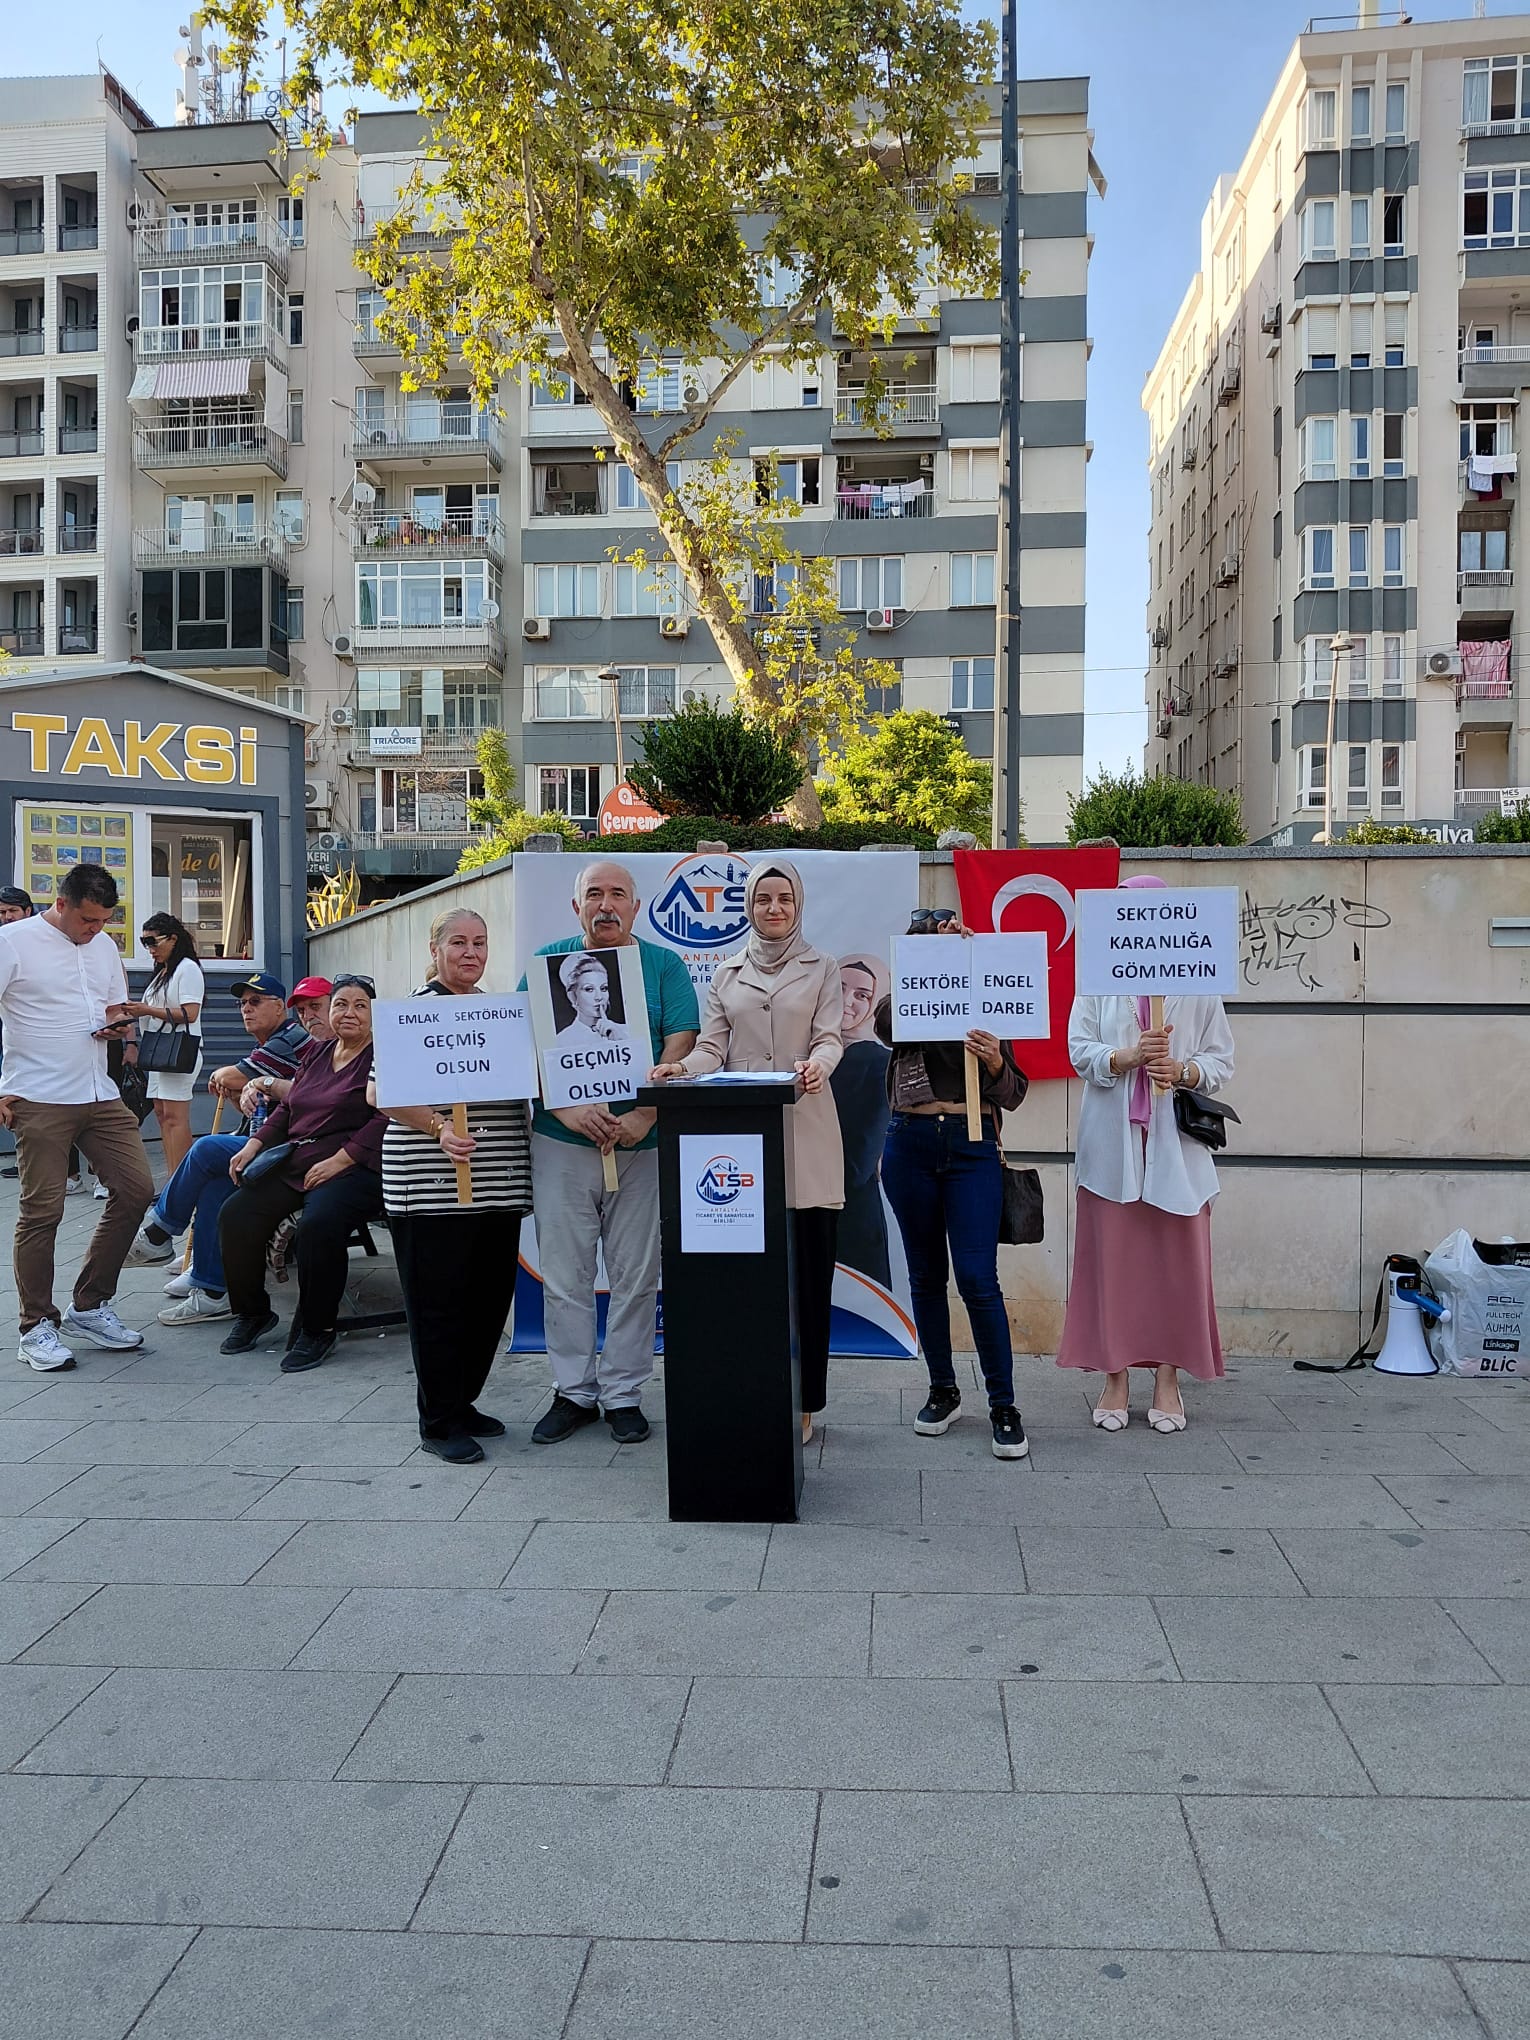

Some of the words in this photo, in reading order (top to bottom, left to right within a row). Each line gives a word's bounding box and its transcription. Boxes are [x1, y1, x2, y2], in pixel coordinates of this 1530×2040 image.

[374, 737, 417, 745] TRIACORE
[1417, 824, 1475, 845] talya
[656, 874, 745, 912] ATS
[1116, 903, 1197, 921] SEKTÖRÜ
[1110, 931, 1212, 950] KARANLIĞA
[683, 953, 736, 961] ANTAL
[697, 963, 710, 971] VE
[1112, 960, 1216, 979] GÖMMEYİN
[901, 973, 970, 990] SEKTÖRE
[984, 974, 1034, 988] ENGEL
[398, 1013, 440, 1025] EMLAK
[454, 1008, 524, 1022] SEKTÖRÜNE
[899, 1000, 970, 1019] GELİŞİME
[982, 1001, 1034, 1015] DARBE
[424, 1030, 486, 1050] GEÇMİŞ
[560, 1045, 632, 1070] GEÇMİŞ
[436, 1059, 490, 1075] OLSUN
[569, 1079, 631, 1100] OLSUN
[699, 1168, 755, 1188] ATSB
[1485, 1312, 1521, 1320] FULLTECH
[1485, 1323, 1521, 1334] AUHMA
[1485, 1340, 1515, 1350] Linkage
